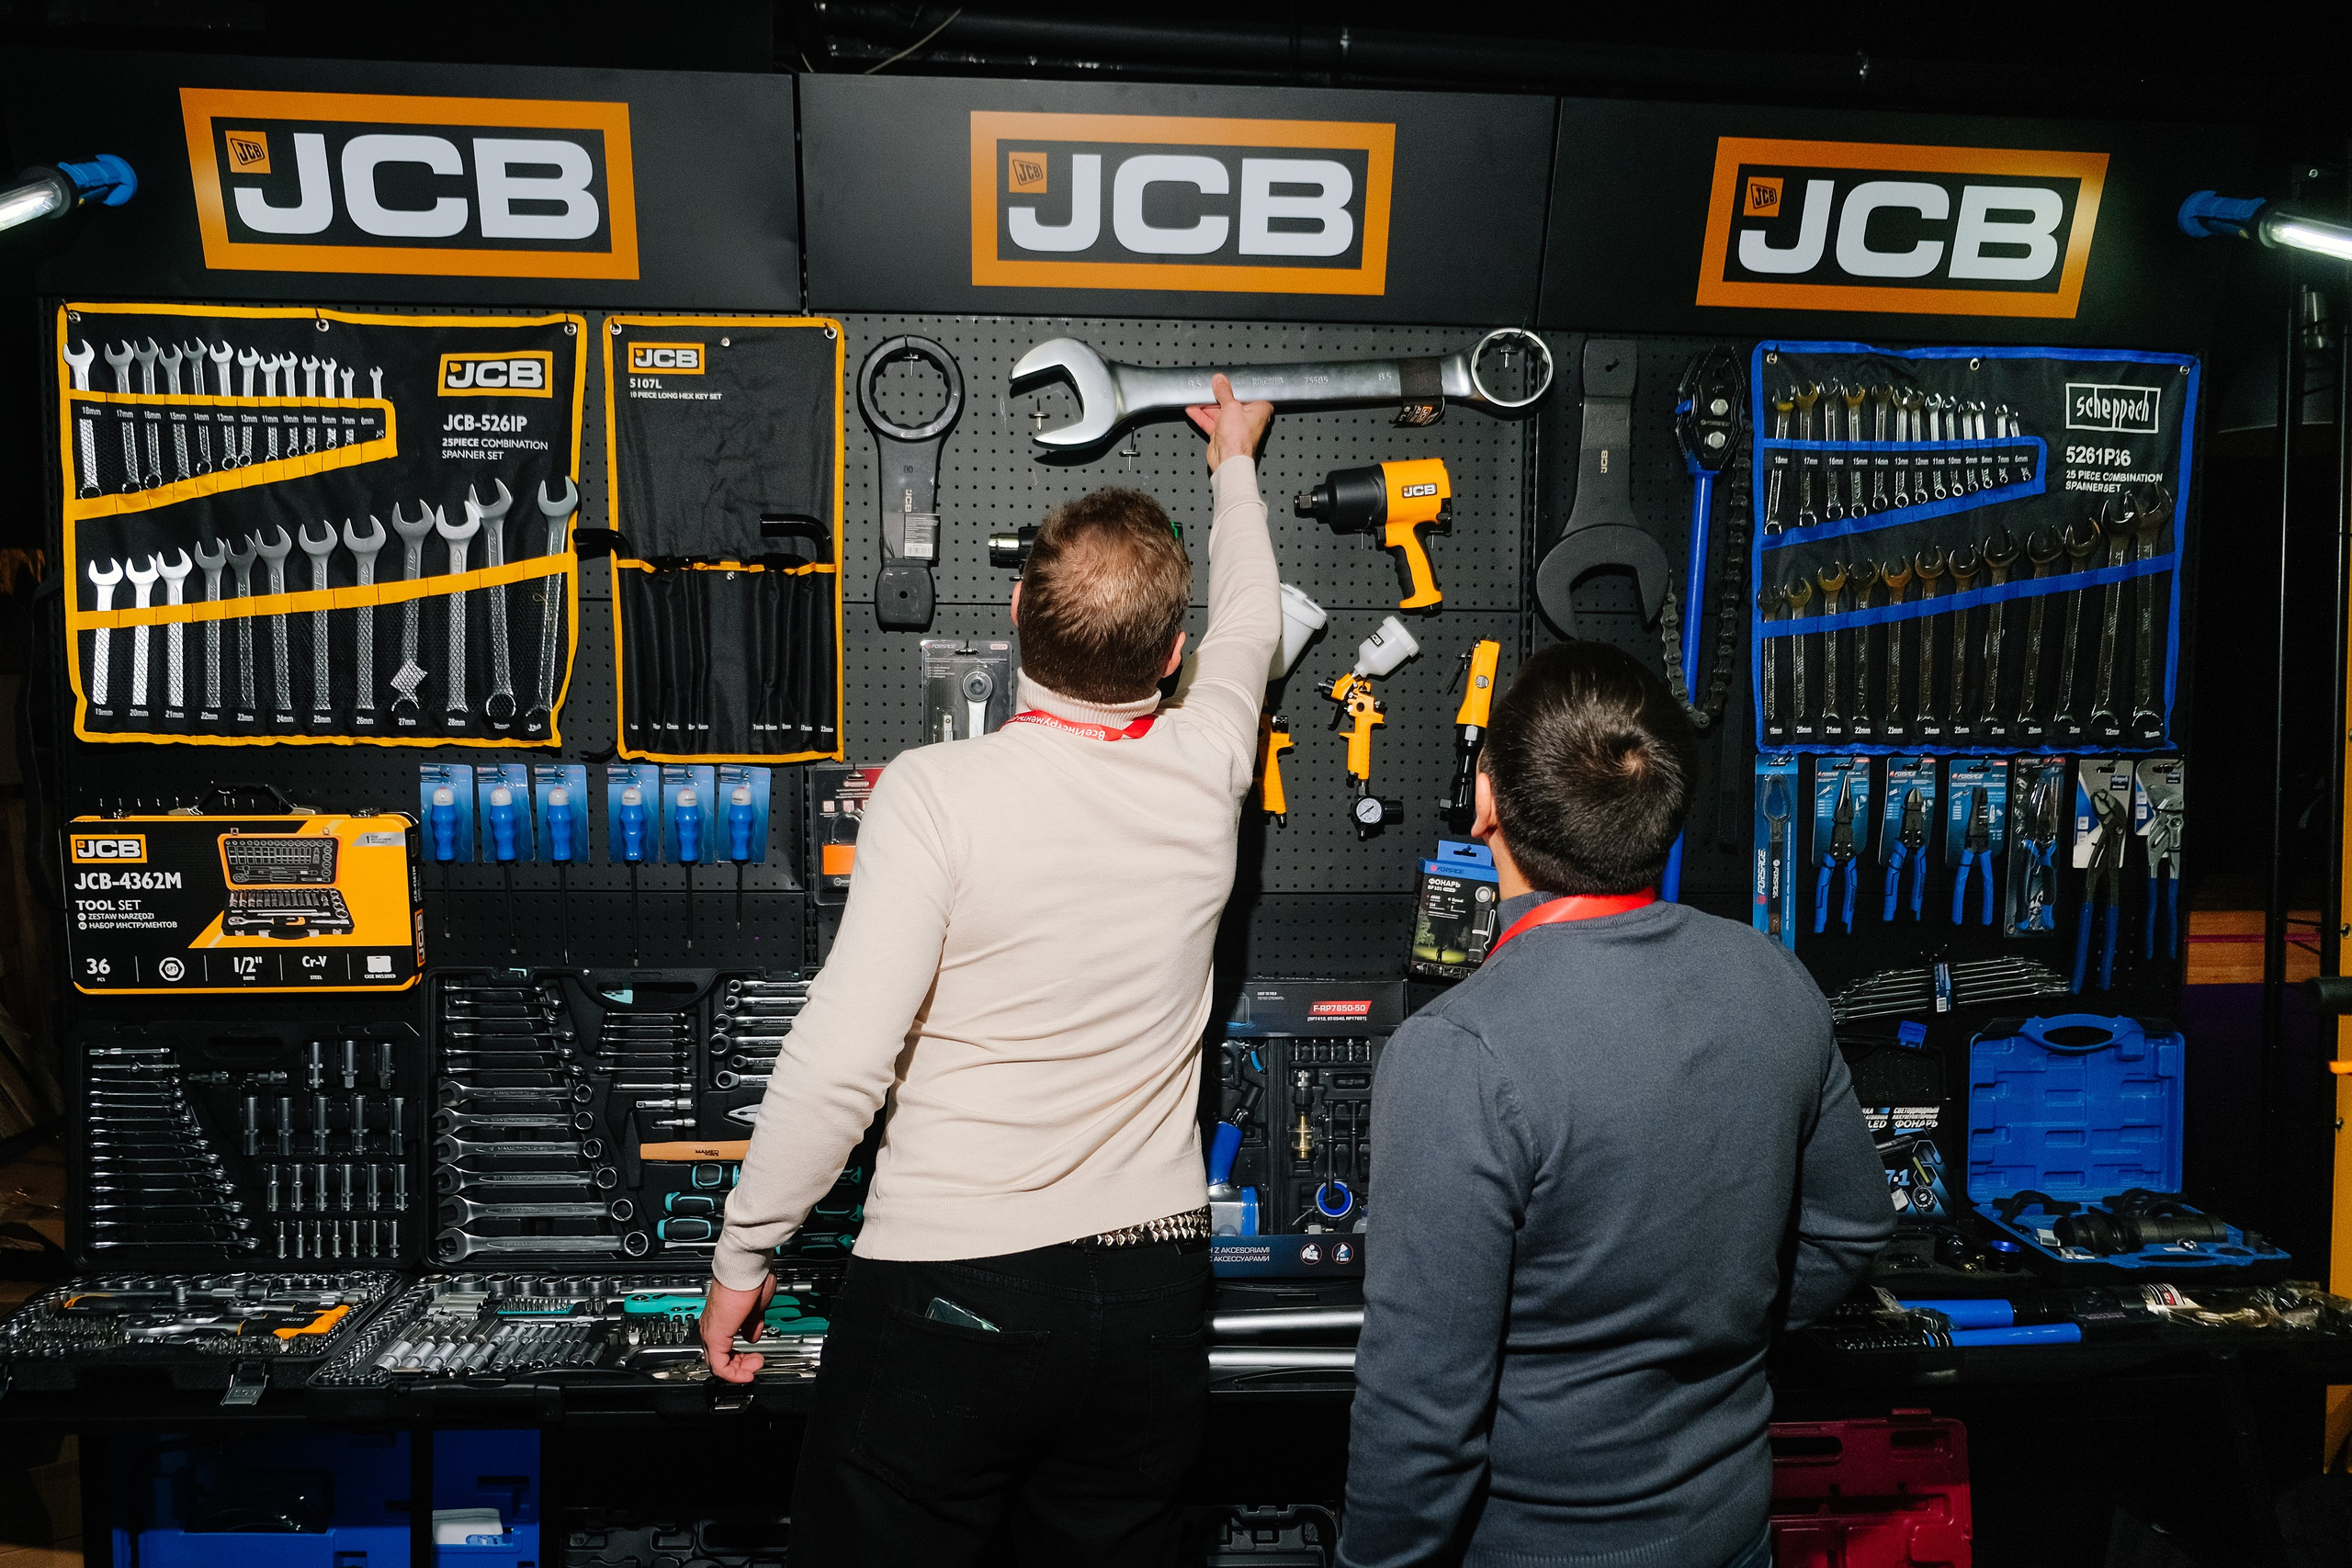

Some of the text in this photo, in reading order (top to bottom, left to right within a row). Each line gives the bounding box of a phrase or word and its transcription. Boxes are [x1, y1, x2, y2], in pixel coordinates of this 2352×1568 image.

[237, 141, 265, 161] JCB
[1018, 162, 1043, 182] JCB
[234, 132, 599, 240] JCB
[1008, 153, 1353, 257] JCB
[1754, 185, 1777, 207] JCB
[1738, 179, 2064, 280] JCB
[635, 349, 698, 367] JCB
[447, 359, 543, 389] JCB
[116, 409, 134, 419] 17mm
[241, 413, 258, 423] 12mm
[2075, 387, 2150, 429] scheppach
[442, 437, 548, 451] 25PIECE COMBINATION
[441, 450, 504, 460] SPANNER SET
[2065, 469, 2163, 483] 25 PIECE COMBINATION
[1402, 484, 1437, 498] JCB
[904, 489, 912, 513] JCB
[77, 840, 141, 858] JCB
[74, 872, 182, 890] JCB-4362M
[1758, 848, 1767, 896] FORSAGE
[1428, 877, 1461, 888] ФОНАРЬ
[1771, 867, 1780, 899] FORSAGE
[75, 899, 141, 911] TOOL SET
[88, 921, 115, 930] НАБОР
[118, 912, 154, 921] NARZĘDZI
[85, 958, 111, 975] 36
[233, 956, 263, 975] 1/2"
[301, 955, 327, 968] Cr-V
[1313, 1004, 1366, 1012] F-RP7850-50
[1867, 1120, 1887, 1129] LED
[1894, 1119, 1939, 1128] ФОНАРЬ
